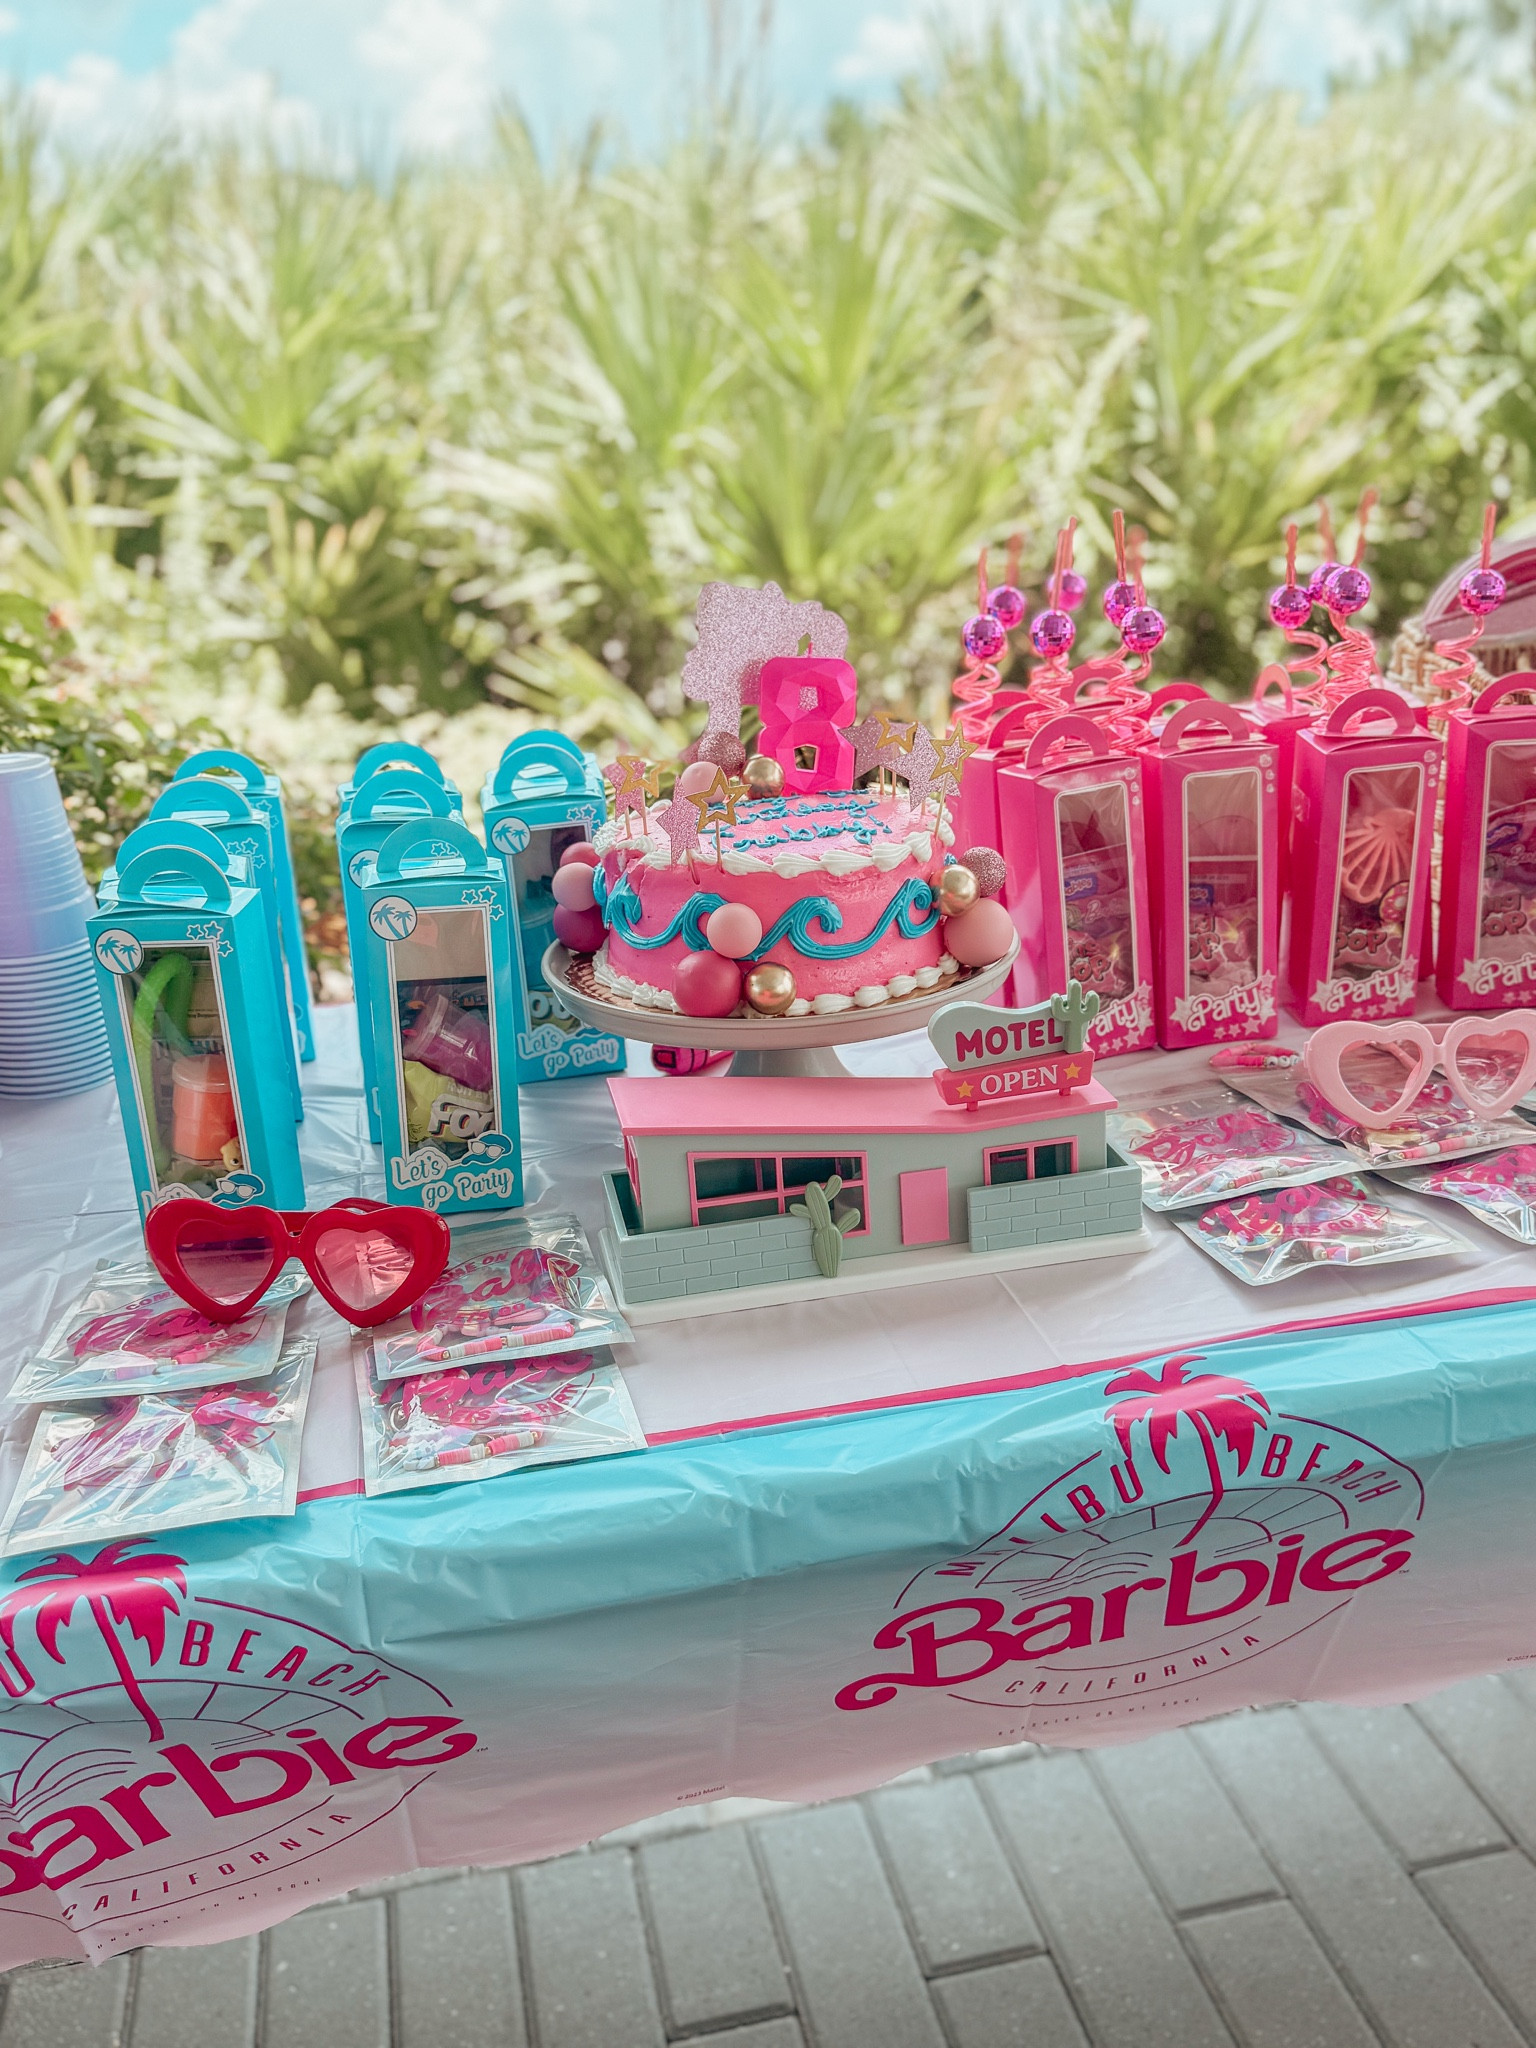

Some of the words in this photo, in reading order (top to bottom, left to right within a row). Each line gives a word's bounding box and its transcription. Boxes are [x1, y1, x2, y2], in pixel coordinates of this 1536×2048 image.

[757, 656, 857, 797] 8
[1326, 971, 1401, 1012] Party
[1475, 956, 1536, 995] Part
[1187, 986, 1262, 1032] Party
[520, 1031, 558, 1055] Let's
[547, 1054, 566, 1076] go
[573, 1041, 615, 1064] Party
[955, 1018, 1064, 1063] MOTEL
[980, 1064, 1059, 1096] OPEN
[396, 1155, 442, 1186] Let's
[425, 1183, 449, 1207] go
[457, 1171, 509, 1197] Party
[125, 1290, 176, 1310] COM
[1261, 1433, 1402, 1503] BEACH
[834, 1528, 1415, 1711] Barbie
[179, 1619, 391, 1697] BEACH
[1004, 1634, 1260, 1695] CALIFORNIA
[61, 1812, 352, 1921] CALIFORNIA
